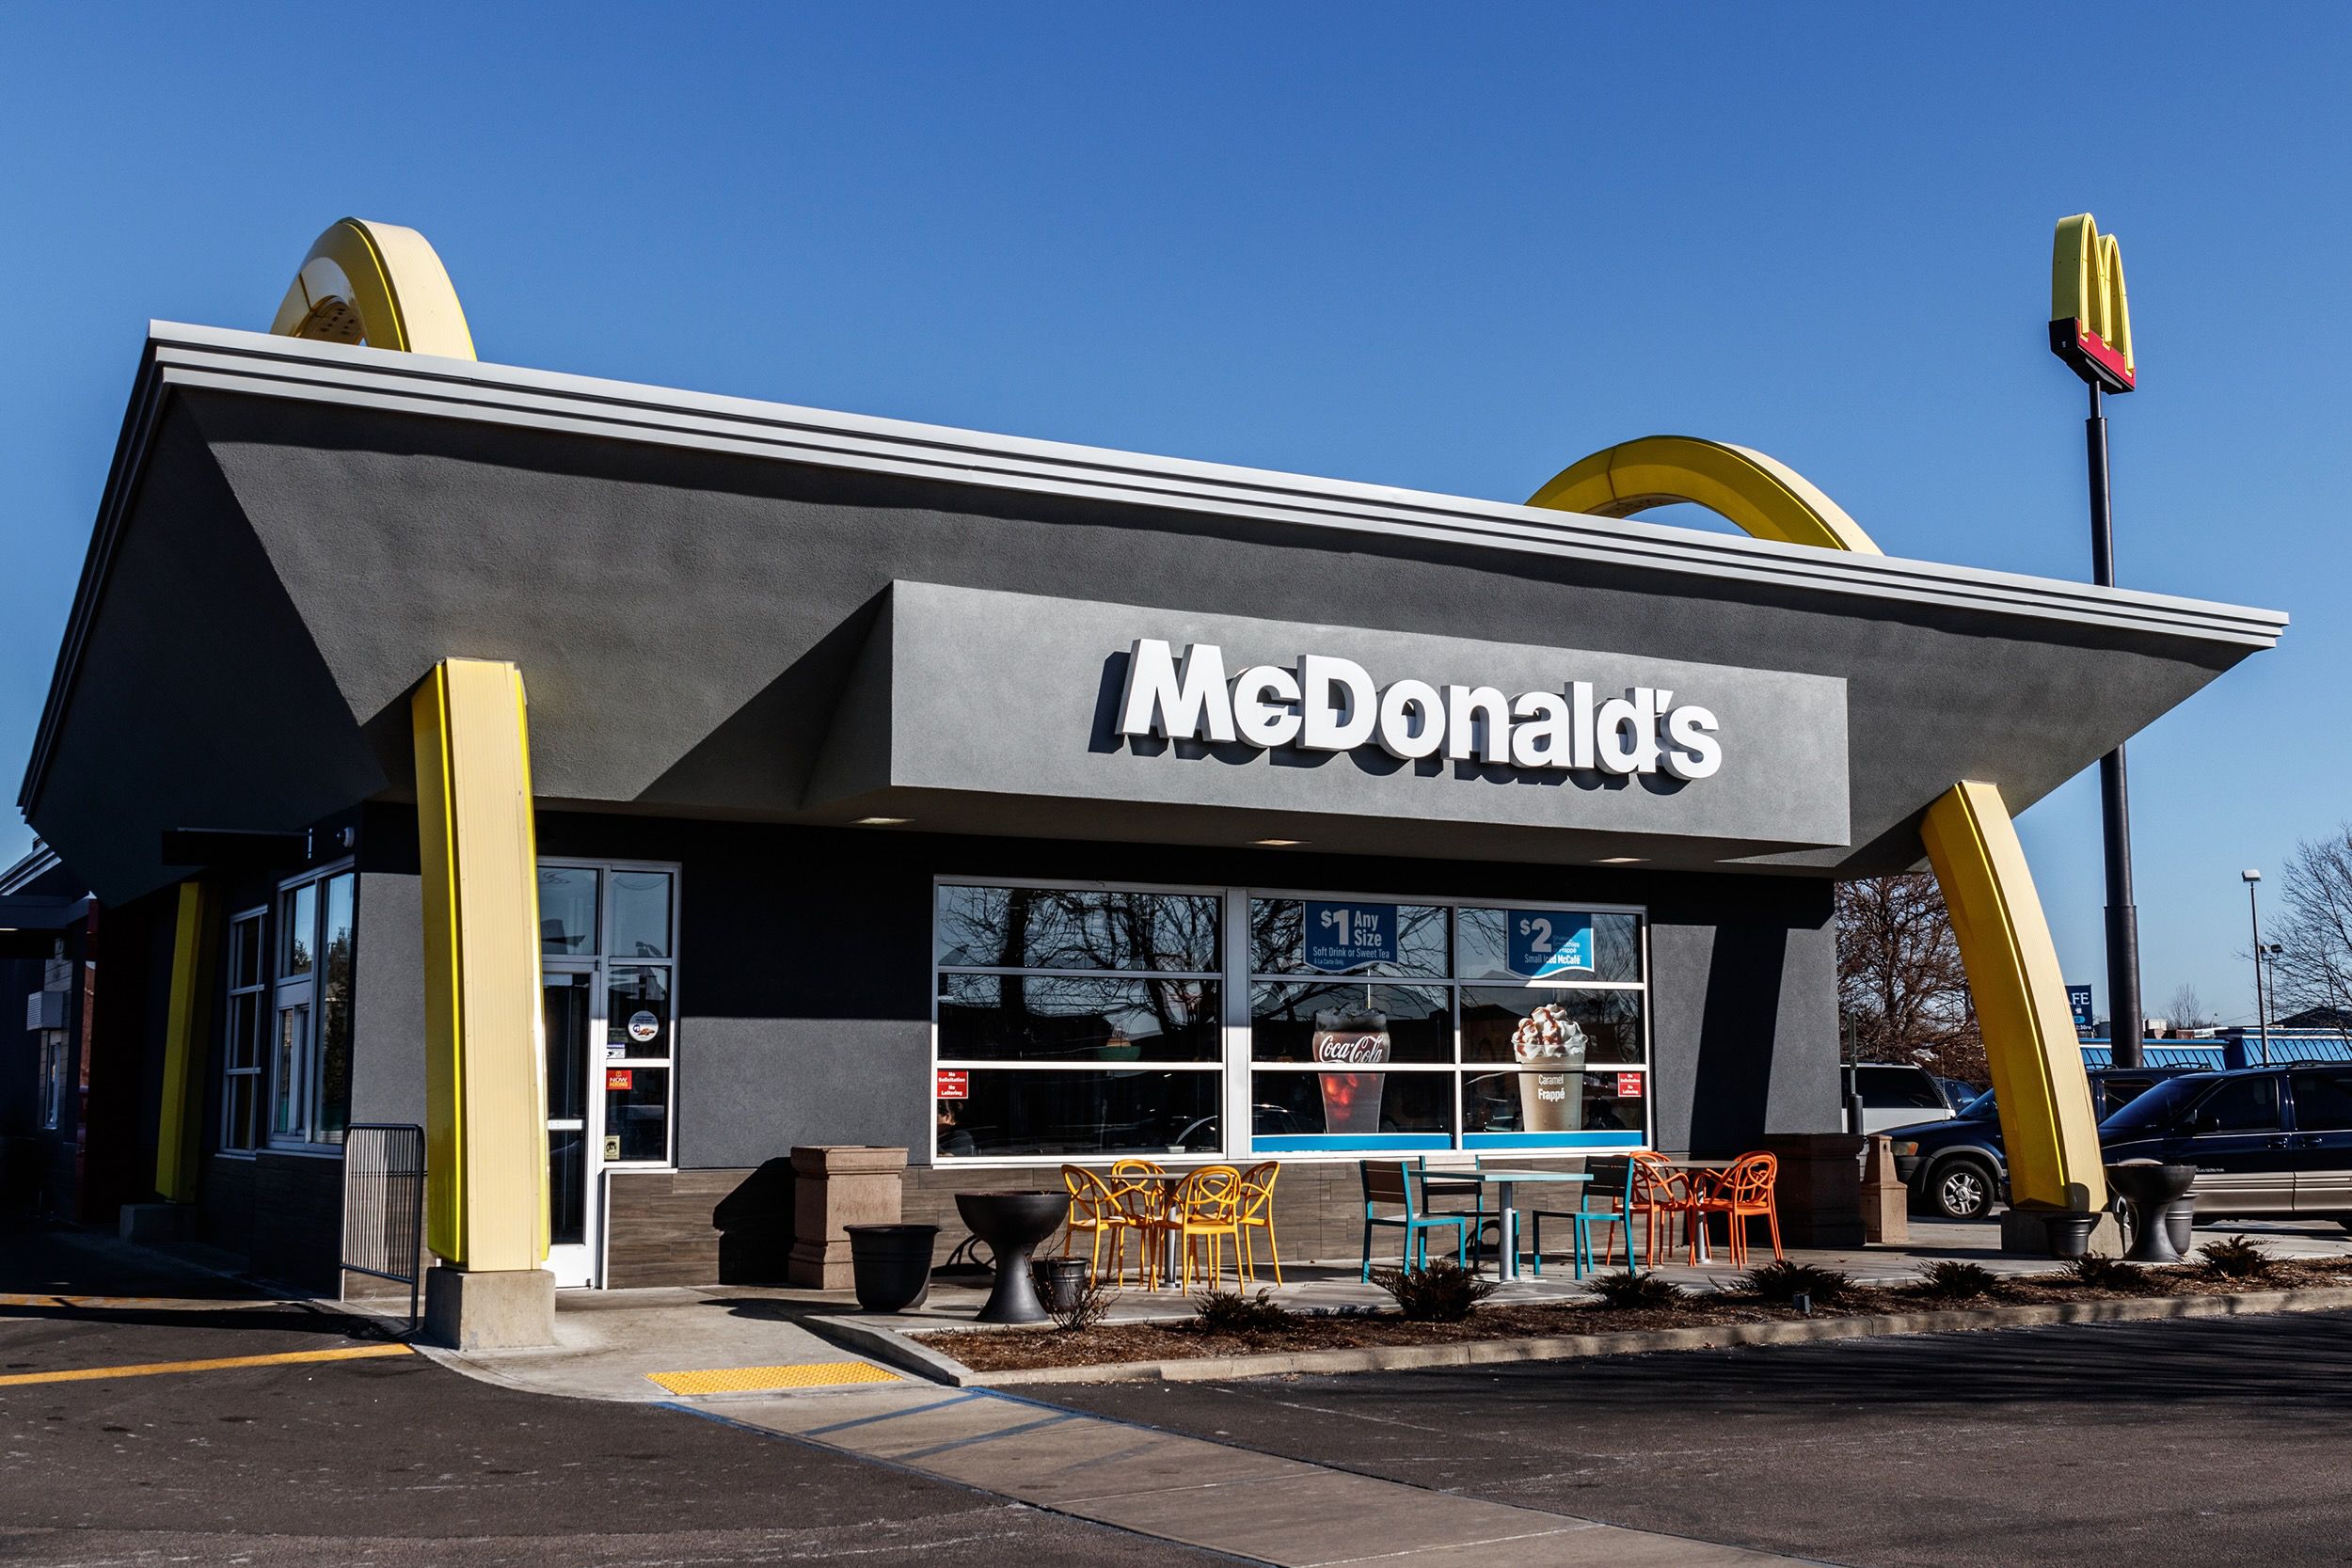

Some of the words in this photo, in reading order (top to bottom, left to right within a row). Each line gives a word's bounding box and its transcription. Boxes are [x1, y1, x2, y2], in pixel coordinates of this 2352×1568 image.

[1118, 638, 1723, 780] McDonald's
[1320, 908, 1349, 946] $1
[1354, 910, 1379, 932] Any
[1354, 928, 1383, 947] Size
[1519, 917, 1552, 953] $2
[1312, 946, 1327, 957] Soft
[1328, 947, 1347, 958] Drink
[1347, 949, 1355, 958] or
[1356, 947, 1377, 958] Sweet
[1378, 949, 1391, 959] Tea
[1524, 954, 1542, 963] Small
[1543, 954, 1557, 964] Iced
[1557, 954, 1581, 965] McCafé
[2071, 991, 2090, 1006] FE
[1538, 1074, 1565, 1085] Caramel
[1537, 1087, 1565, 1102] Frappé
